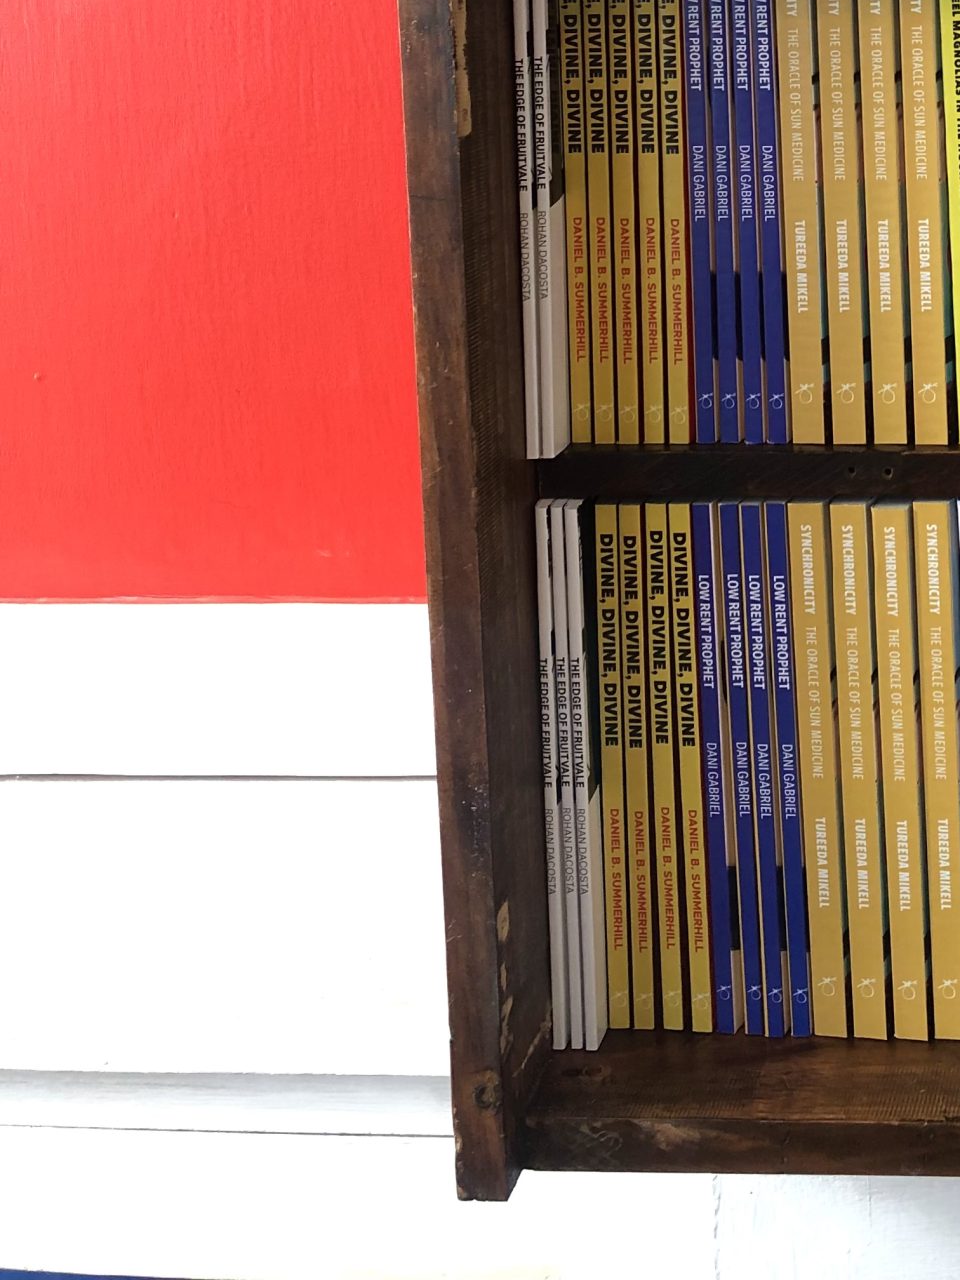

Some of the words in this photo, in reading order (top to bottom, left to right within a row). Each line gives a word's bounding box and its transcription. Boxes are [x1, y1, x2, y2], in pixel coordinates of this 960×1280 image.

[756, 5, 767, 34] RENT
[911, 25, 922, 43] THE
[534, 57, 542, 77] THE
[660, 13, 680, 86] DIVINE,
[757, 37, 769, 90] PROPHET
[911, 48, 923, 85] ORACLE
[534, 81, 543, 109] EDGE
[913, 89, 924, 102] OF
[535, 113, 543, 127] OF
[663, 88, 682, 154] DIVINE
[914, 106, 925, 126] SUN
[536, 130, 545, 189] FRUITVALE
[761, 145, 772, 171] DANI
[914, 130, 927, 179] MEDICINE
[762, 175, 774, 221] GABRIEL
[537, 210, 546, 249] ROHAN
[670, 218, 682, 264] DANIEL
[918, 218, 930, 267] TUREEDA
[538, 250, 548, 299] DACOSTA
[671, 268, 680, 279] B.
[920, 271, 931, 312] MIKELL
[672, 284, 684, 364] SUMMERHILL
[773, 575, 785, 601] LOW
[775, 604, 786, 633] RENT
[776, 636, 789, 689] PROPHET
[781, 744, 793, 770] DANI
[783, 773, 795, 819] GABRIEL
